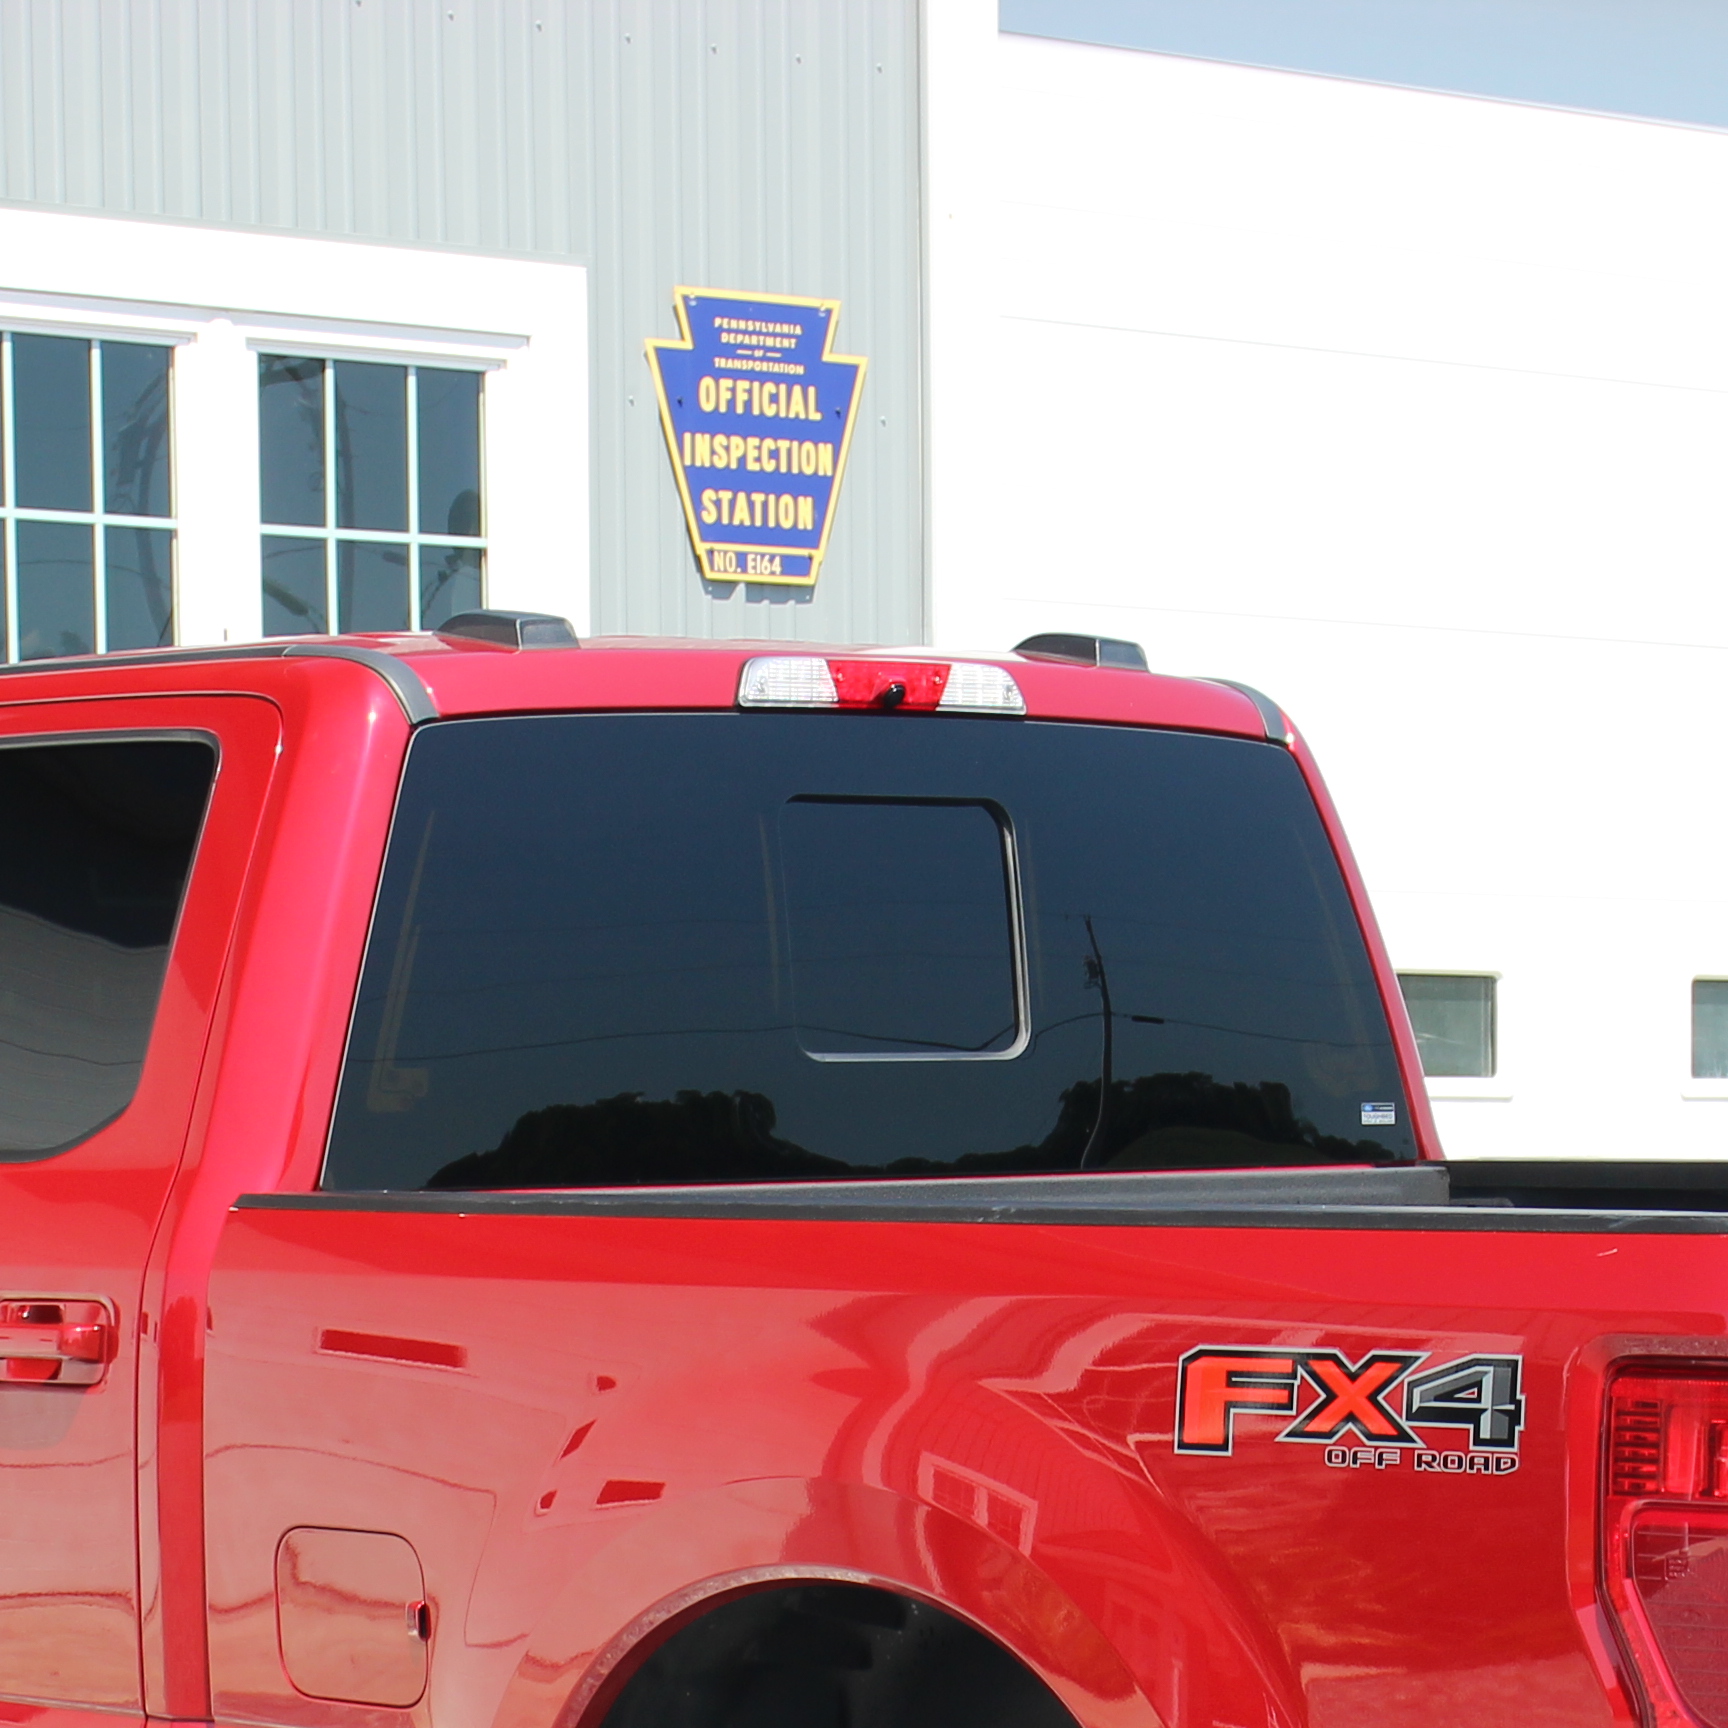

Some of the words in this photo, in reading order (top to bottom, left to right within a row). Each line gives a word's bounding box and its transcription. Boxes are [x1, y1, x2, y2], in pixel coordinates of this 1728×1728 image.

[714, 317, 802, 335] PENNSYLVANIA
[720, 332, 798, 349] DEPARTMENT
[714, 357, 805, 375] TRANSPORTATION
[698, 375, 823, 421] OFFICIAL
[682, 431, 834, 477] INSPECTION
[700, 488, 814, 531] STATION
[713, 550, 742, 573] NO.
[747, 552, 783, 575] E164
[1174, 1343, 1526, 1457] FX4
[1324, 1446, 1401, 1470] OFF
[1414, 1448, 1519, 1475] ROAD
